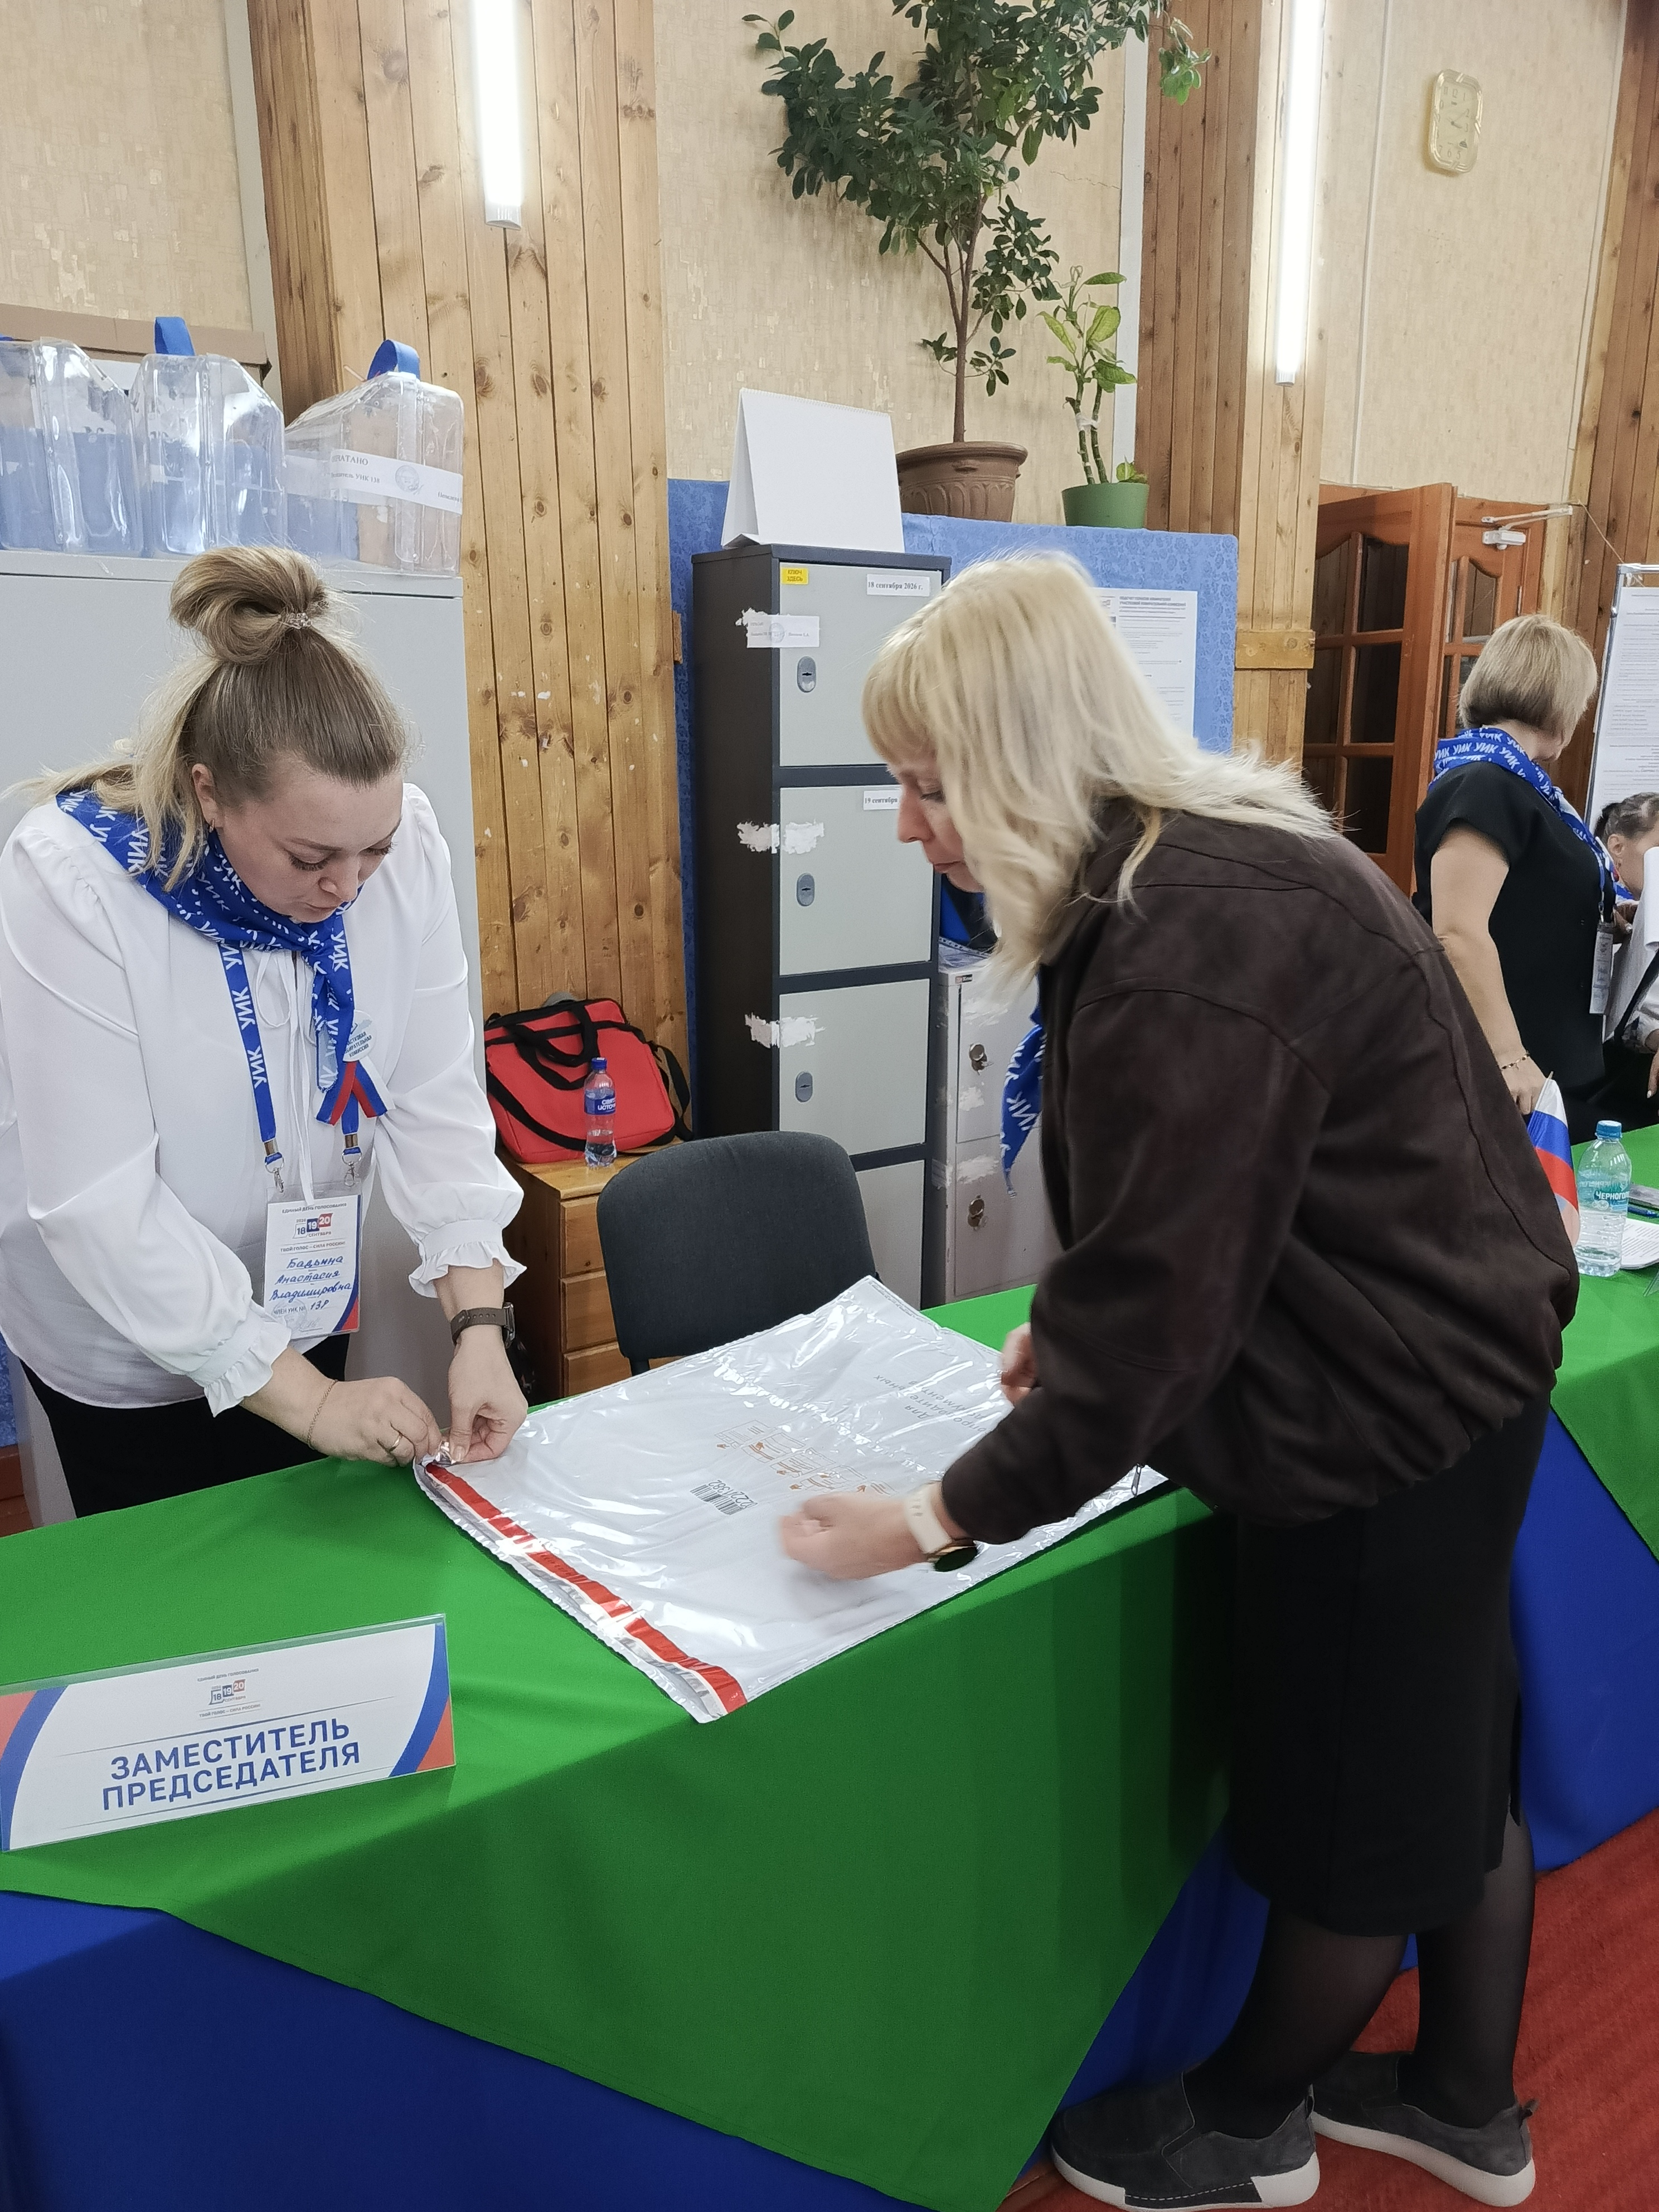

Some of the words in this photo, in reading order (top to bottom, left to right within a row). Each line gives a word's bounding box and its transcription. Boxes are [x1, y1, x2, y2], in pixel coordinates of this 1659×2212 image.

[876, 582, 903, 590] сентября
[1453, 743, 1472, 755] УИК
[1473, 742, 1498, 753] УИК
[1499, 747, 1520, 769] УИК
[127, 828, 149, 874] УИК
[221, 943, 242, 970] УИ
[331, 930, 349, 972] УИК
[232, 986, 256, 1030] УИК
[247, 1045, 267, 1089] УИК
[308, 1221, 317, 1230] 19
[319, 1216, 331, 1225] 20
[274, 1270, 340, 1285] Анастасия
[269, 1281, 352, 1303] Владимировна
[904, 1405, 933, 1419] Для
[234, 1682, 244, 1690] 20
[111, 1718, 350, 1780] ЗАМЕСТИТЕЛЬ
[103, 1742, 360, 1810] ПРЕДСЕДАТЕЛЯ
